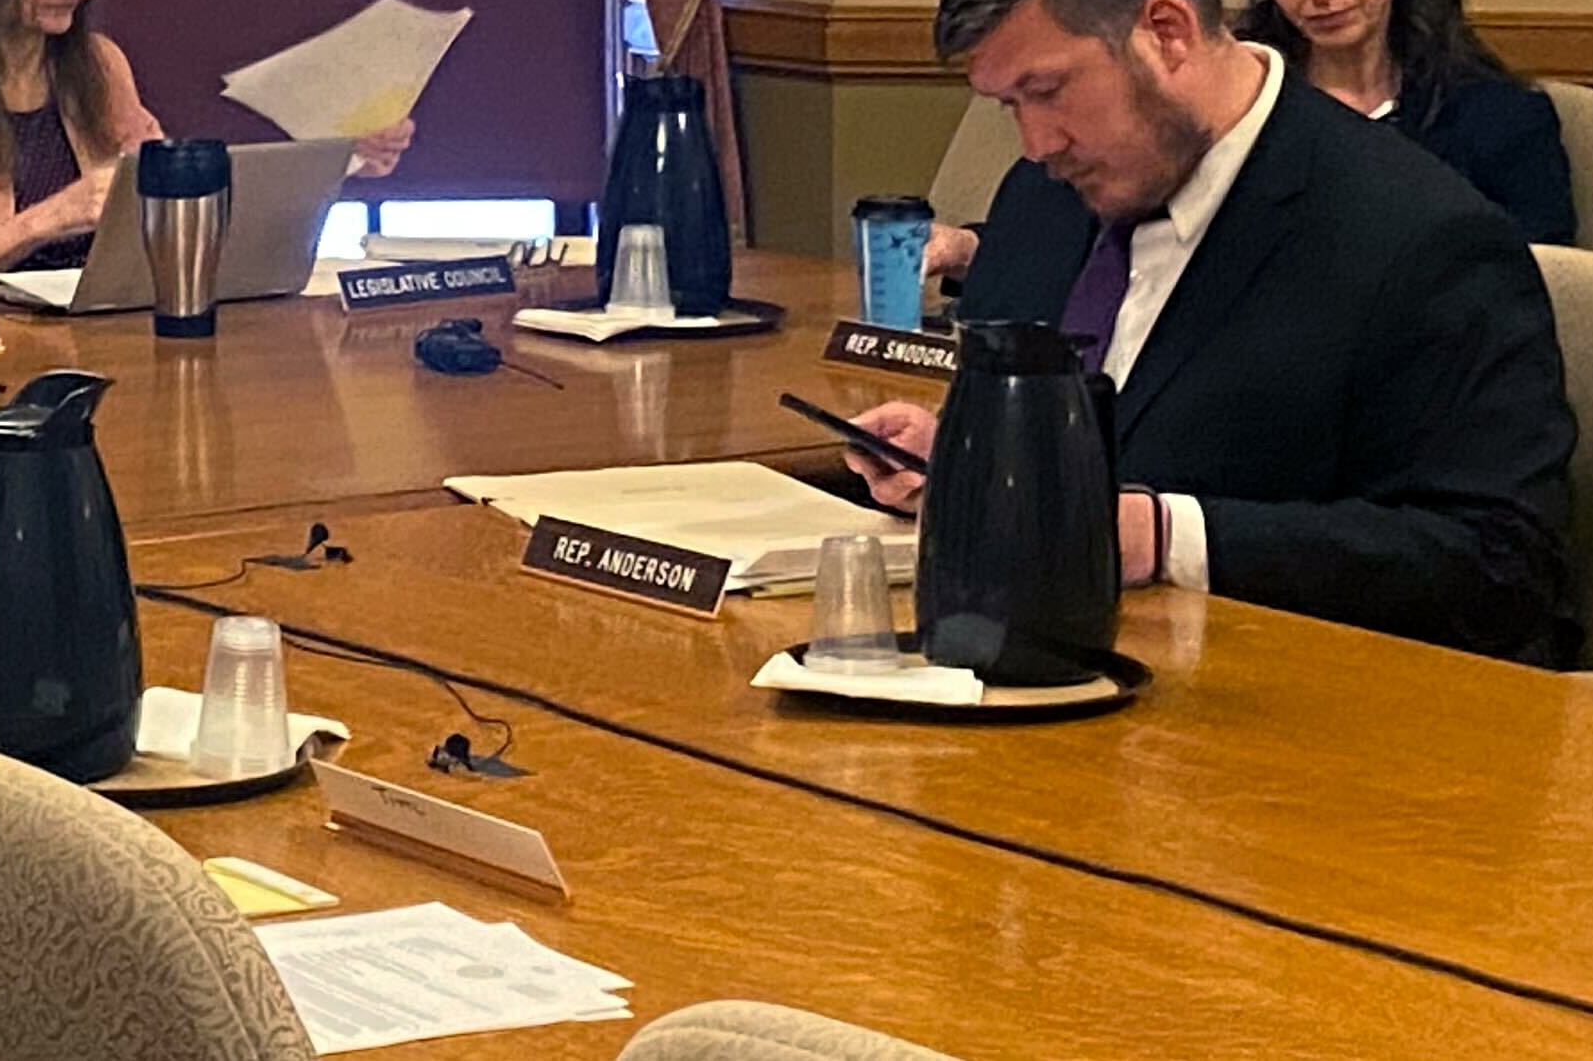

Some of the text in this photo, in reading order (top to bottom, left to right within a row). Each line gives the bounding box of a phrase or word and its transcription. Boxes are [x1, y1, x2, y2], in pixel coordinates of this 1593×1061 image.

[347, 266, 507, 299] LEGISLATIVE COUNCIL
[845, 332, 878, 357] REP.
[552, 535, 697, 592] REP. ANDERSON
